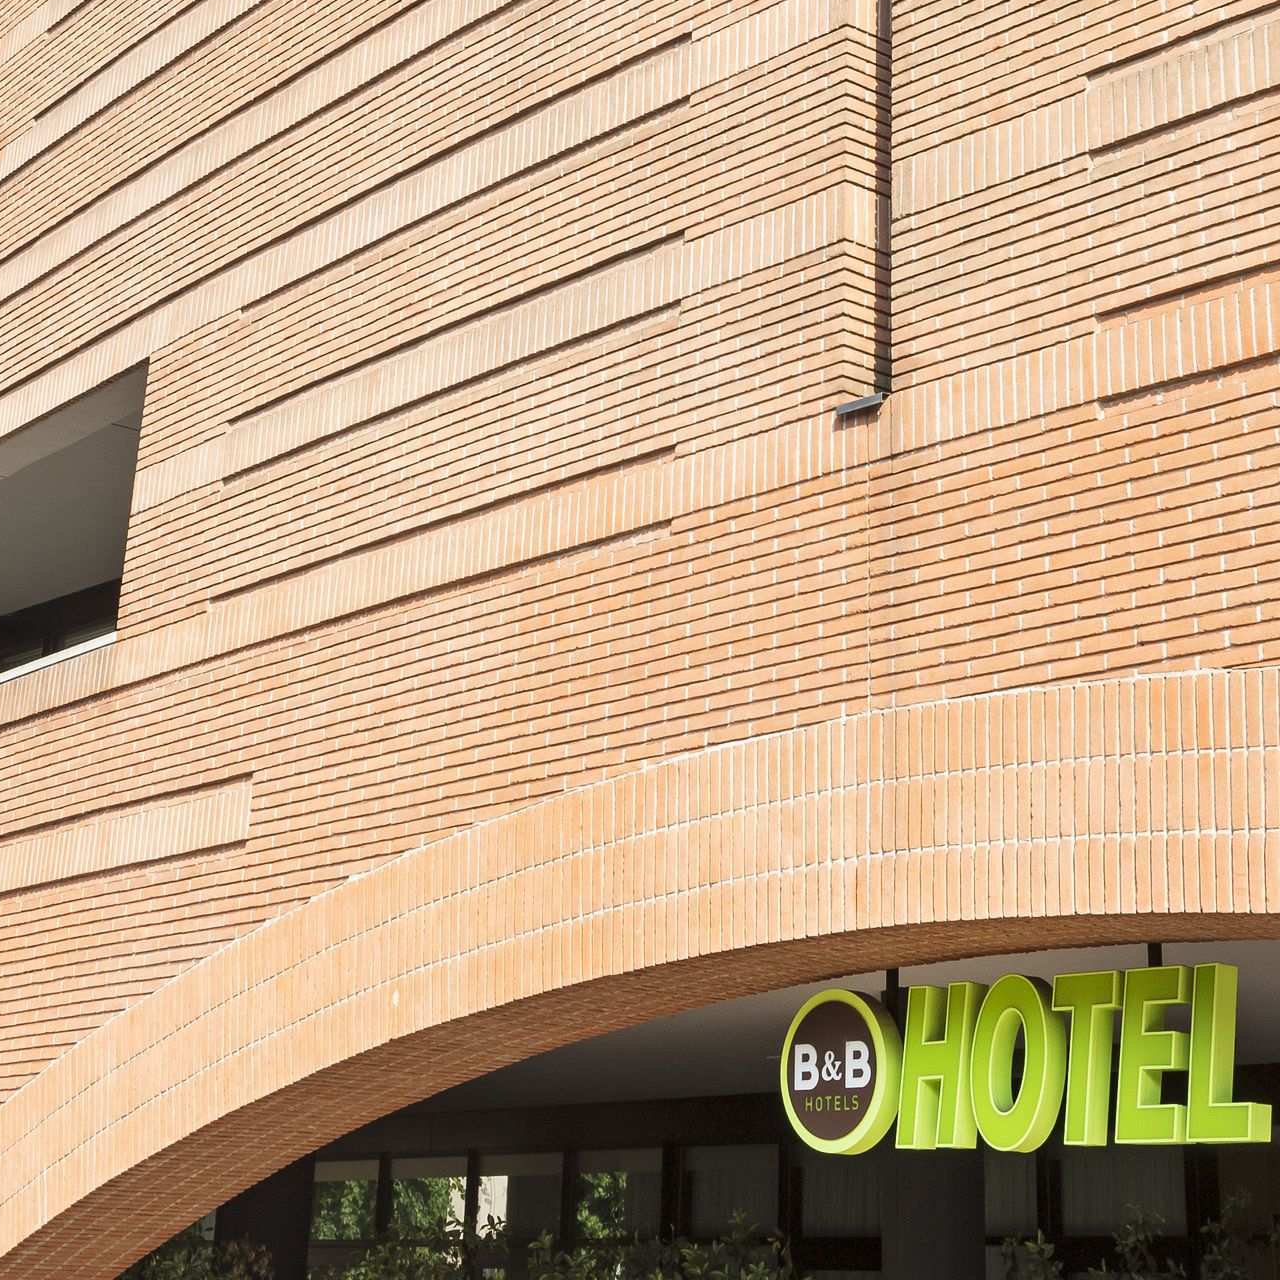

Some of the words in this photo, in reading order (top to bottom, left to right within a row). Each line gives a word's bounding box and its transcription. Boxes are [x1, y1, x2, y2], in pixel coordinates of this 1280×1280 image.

[794, 1040, 872, 1091] B&B
[895, 962, 1272, 1154] HOTEL
[805, 1094, 860, 1112] HOTELS
